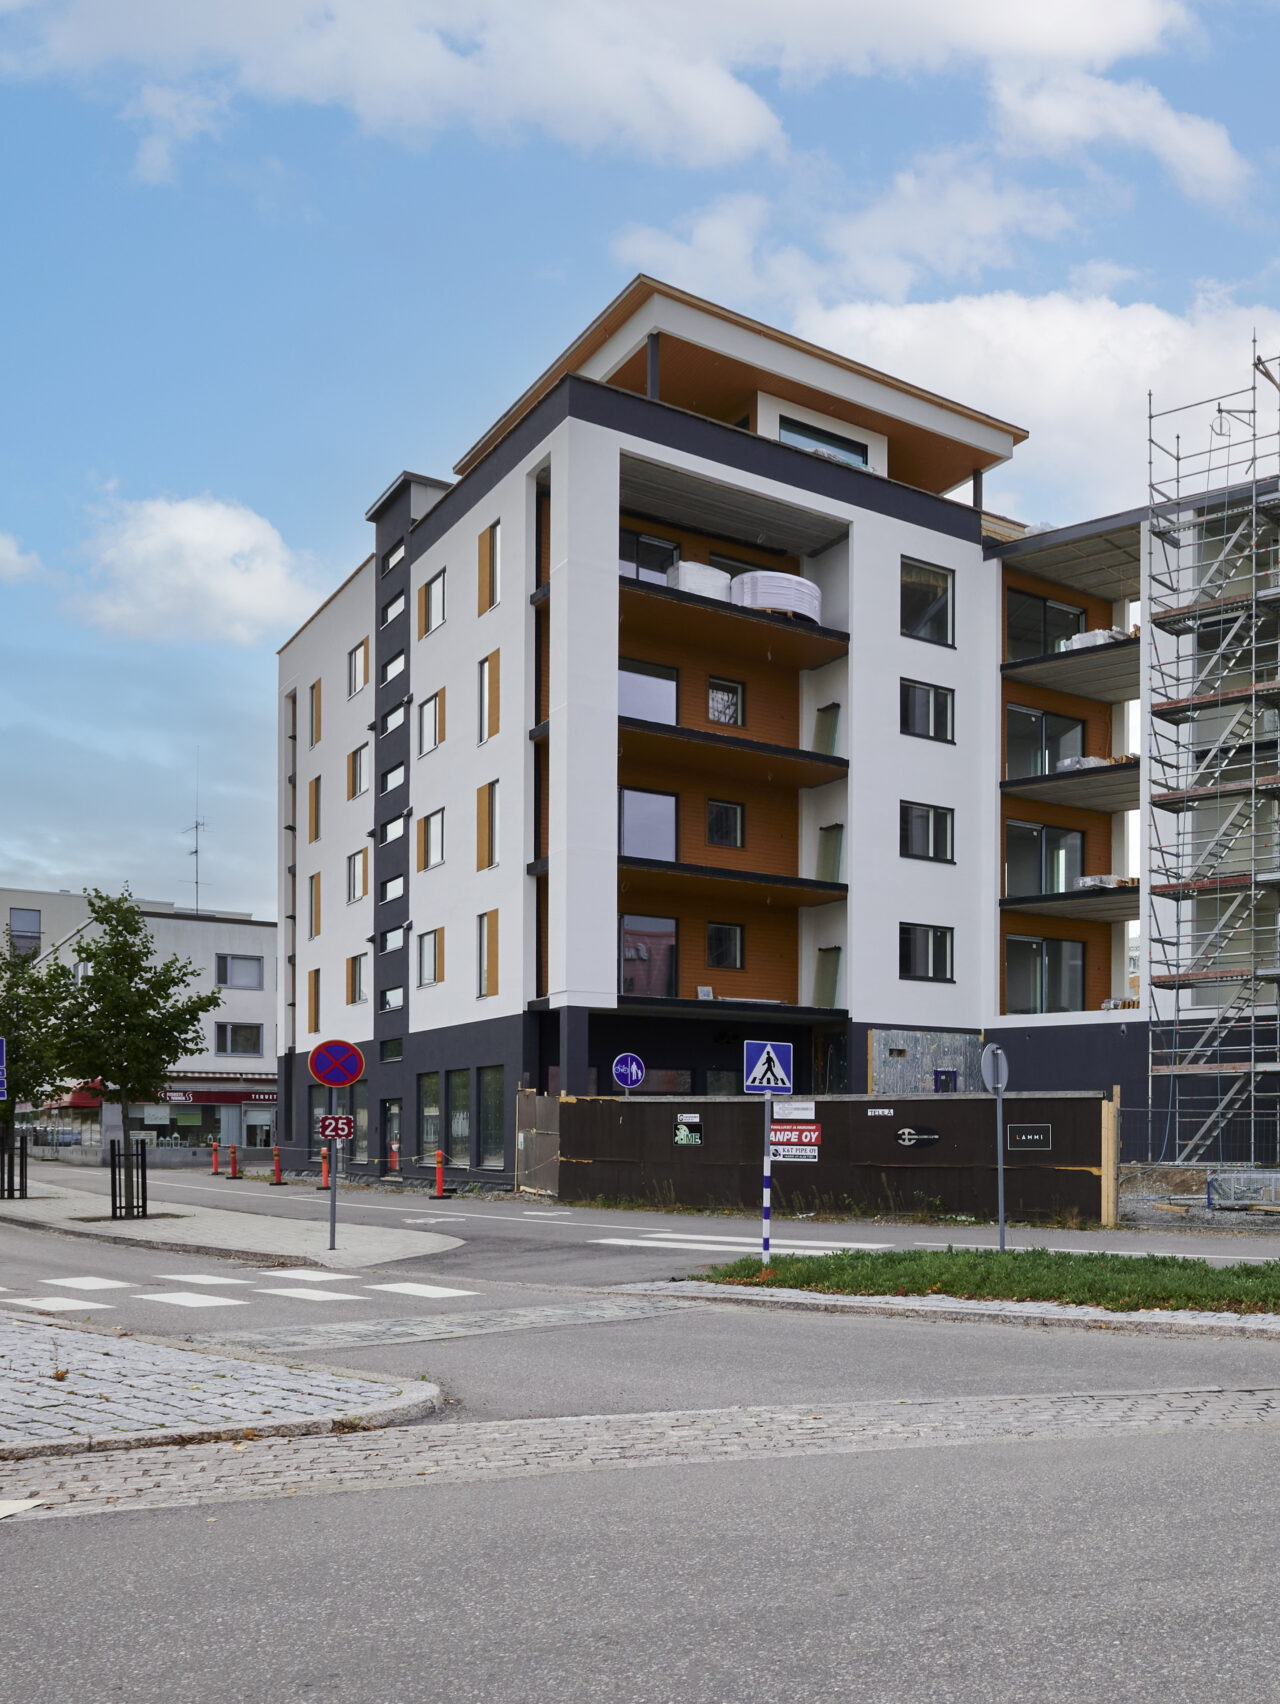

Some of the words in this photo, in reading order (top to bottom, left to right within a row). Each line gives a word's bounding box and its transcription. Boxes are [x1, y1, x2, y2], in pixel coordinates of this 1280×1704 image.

[325, 1119, 349, 1135] 25
[770, 1131, 799, 1142] ANPE
[802, 1131, 819, 1142] OY
